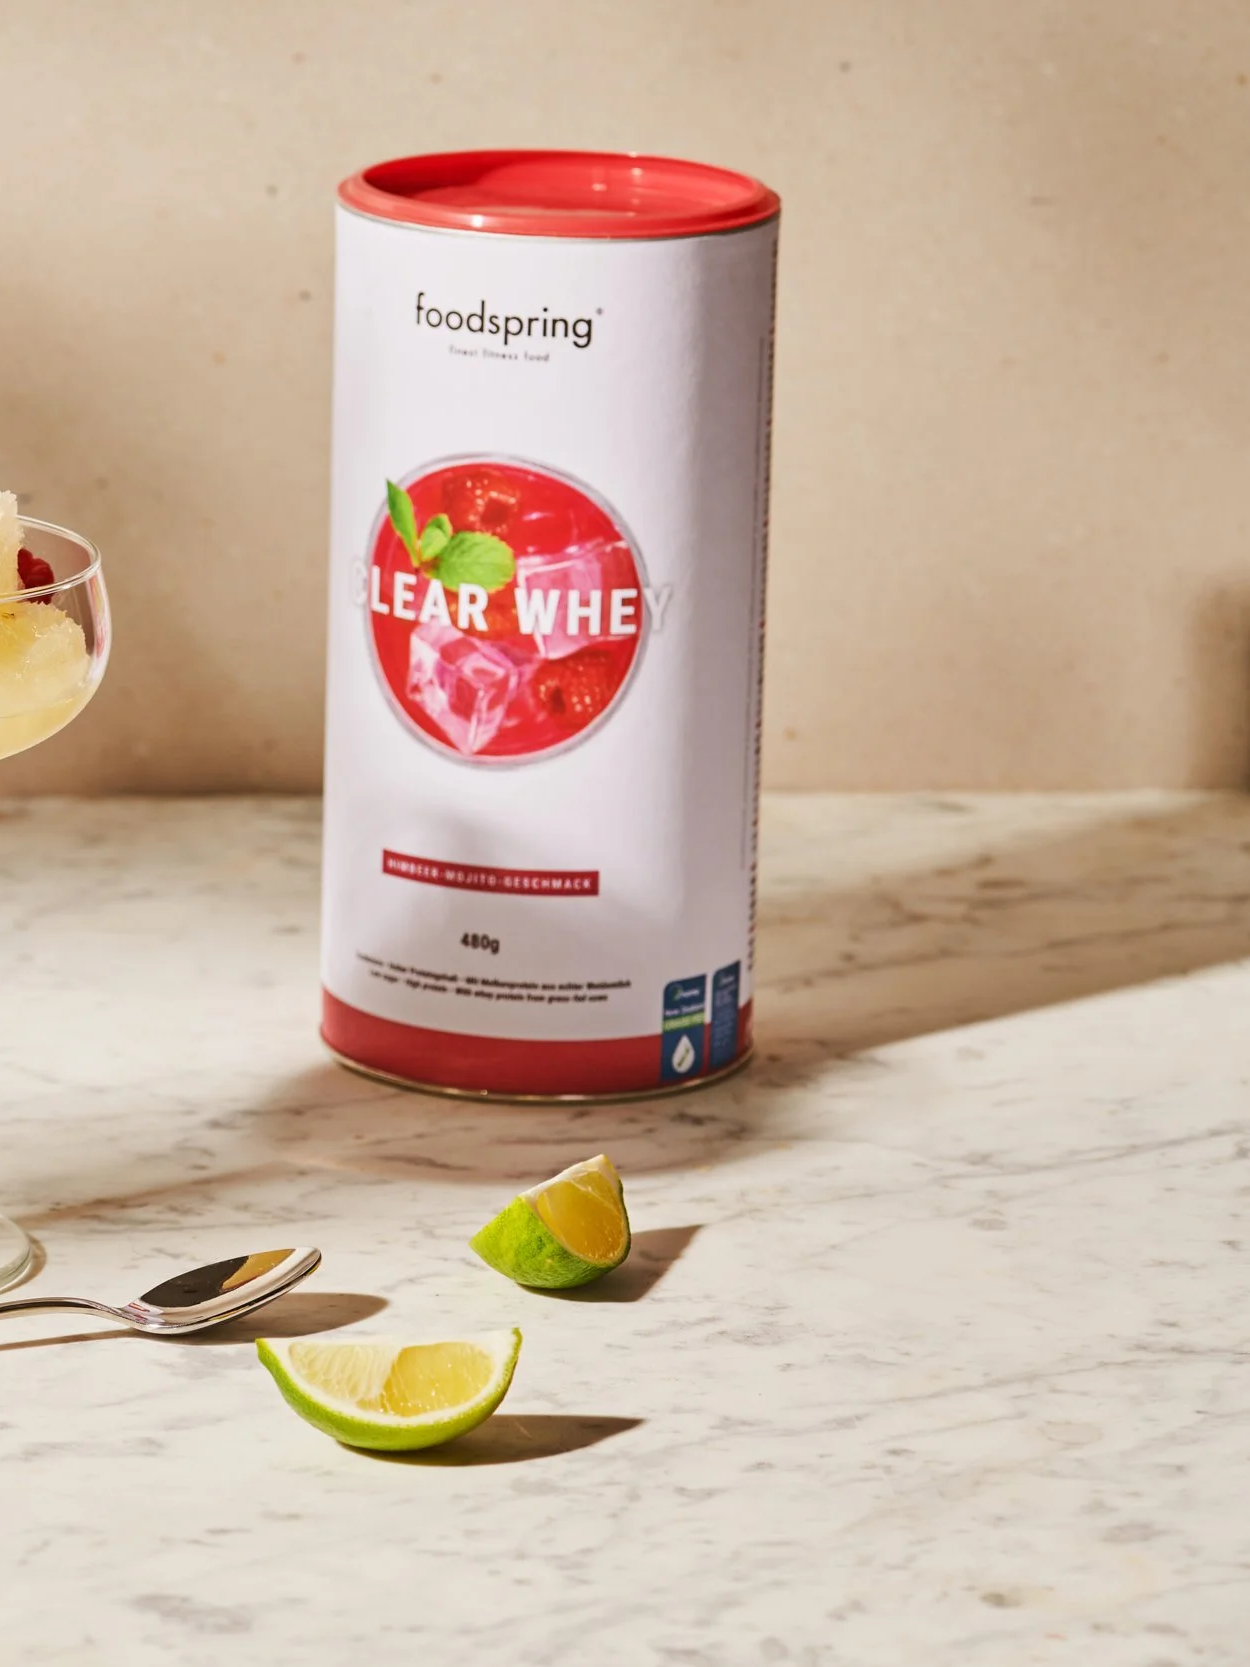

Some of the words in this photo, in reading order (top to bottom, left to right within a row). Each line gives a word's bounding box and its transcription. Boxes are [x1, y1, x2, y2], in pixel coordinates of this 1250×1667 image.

[416, 292, 593, 349] foodspring
[514, 586, 674, 636] WHEY
[461, 932, 500, 954] 480g
